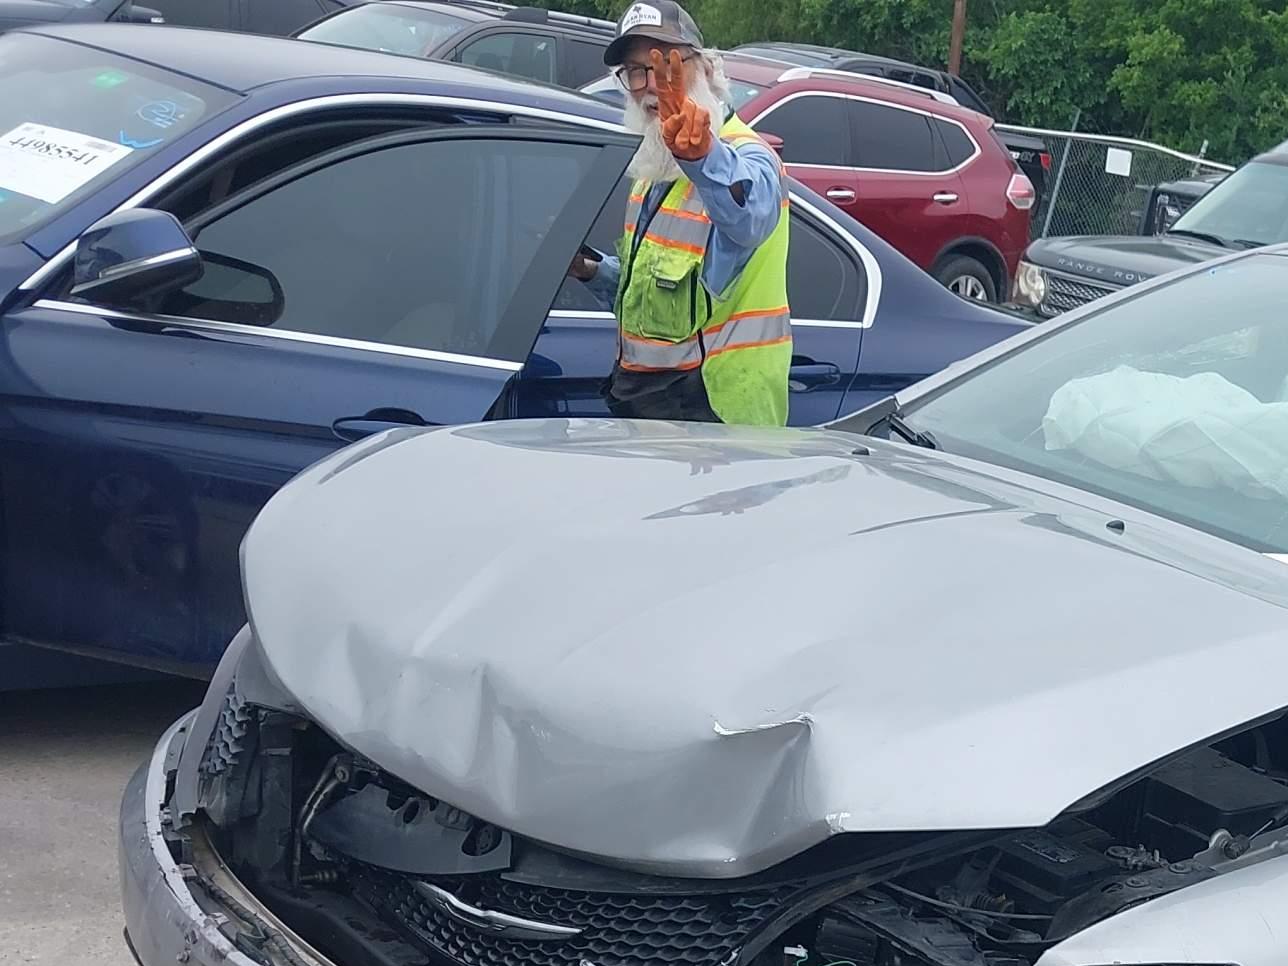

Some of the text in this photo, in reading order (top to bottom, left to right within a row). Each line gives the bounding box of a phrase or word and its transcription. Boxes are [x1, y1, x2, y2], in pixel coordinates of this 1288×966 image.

[9, 136, 99, 165] 44985541
[1057, 258, 1147, 281] RANGE ROV
